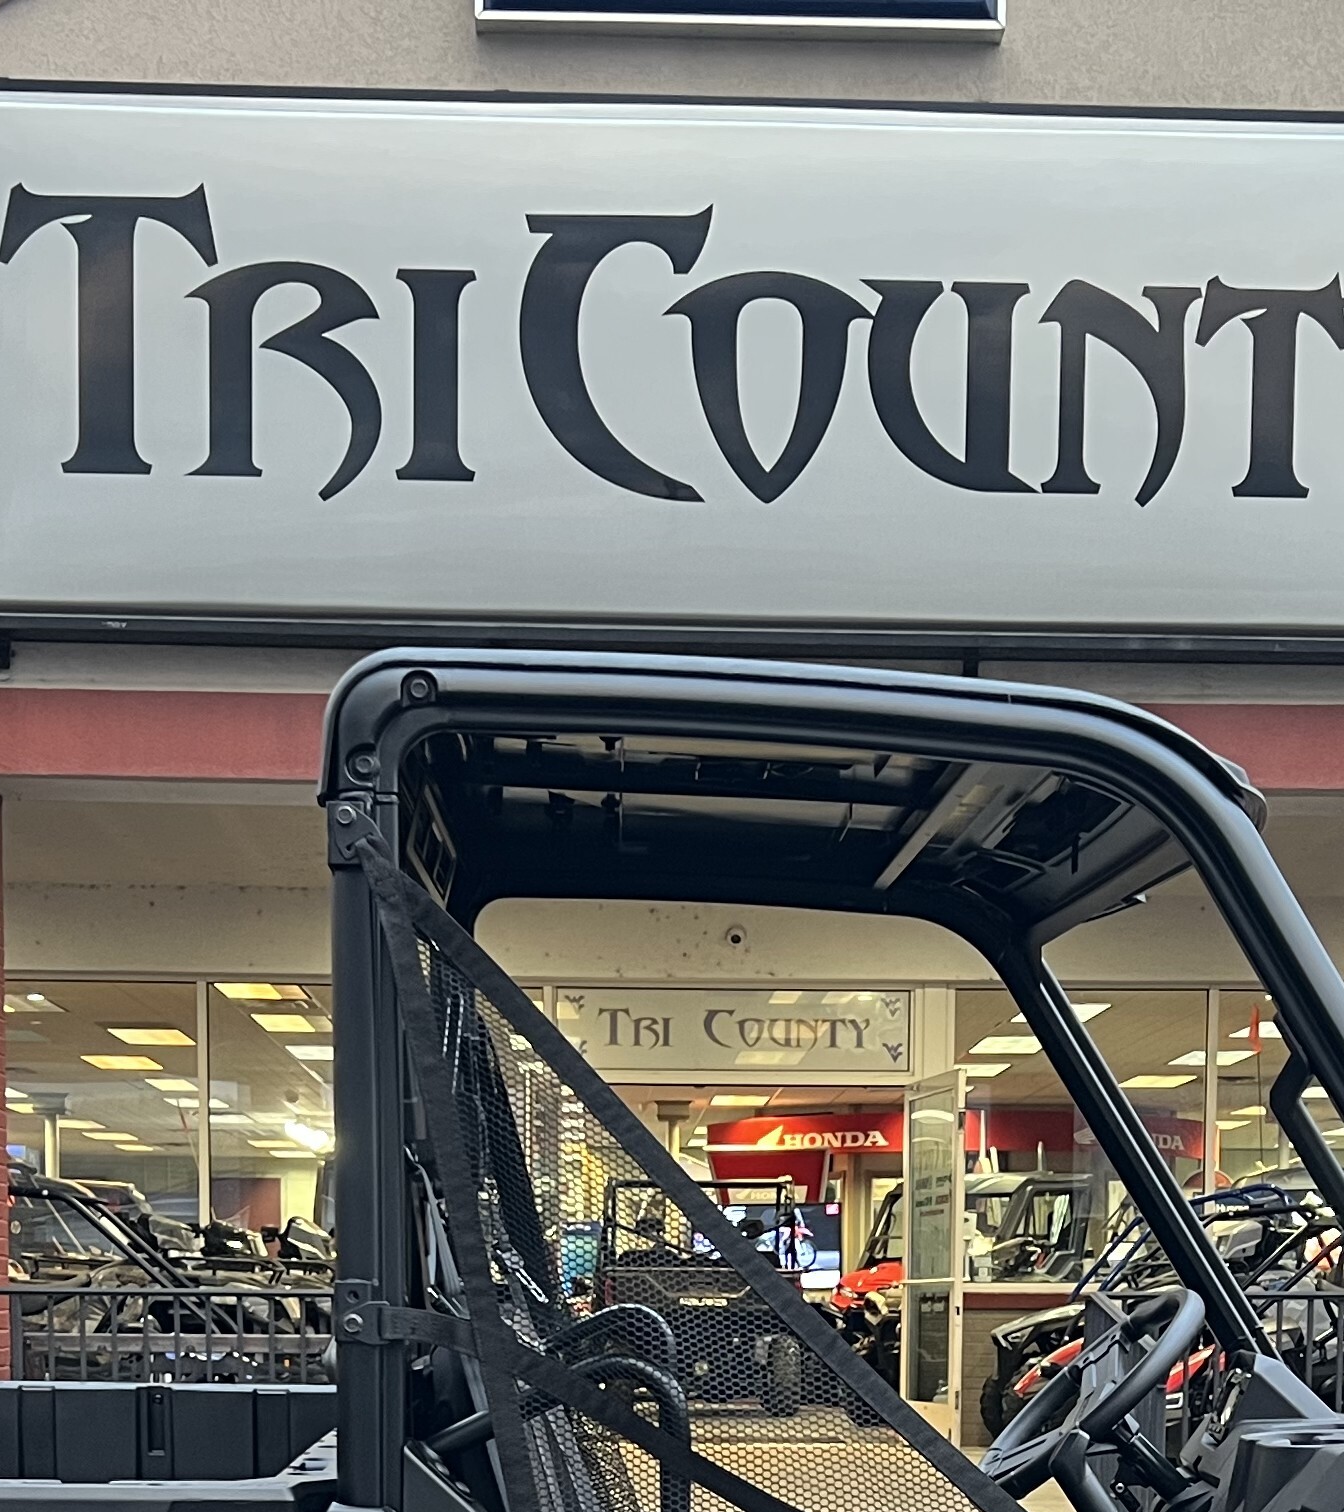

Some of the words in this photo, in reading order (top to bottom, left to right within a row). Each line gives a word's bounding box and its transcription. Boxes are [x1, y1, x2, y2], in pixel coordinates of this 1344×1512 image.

[598, 1007, 674, 1050] TRI
[703, 1008, 871, 1053] COUNTY
[782, 1130, 890, 1149] HONDA
